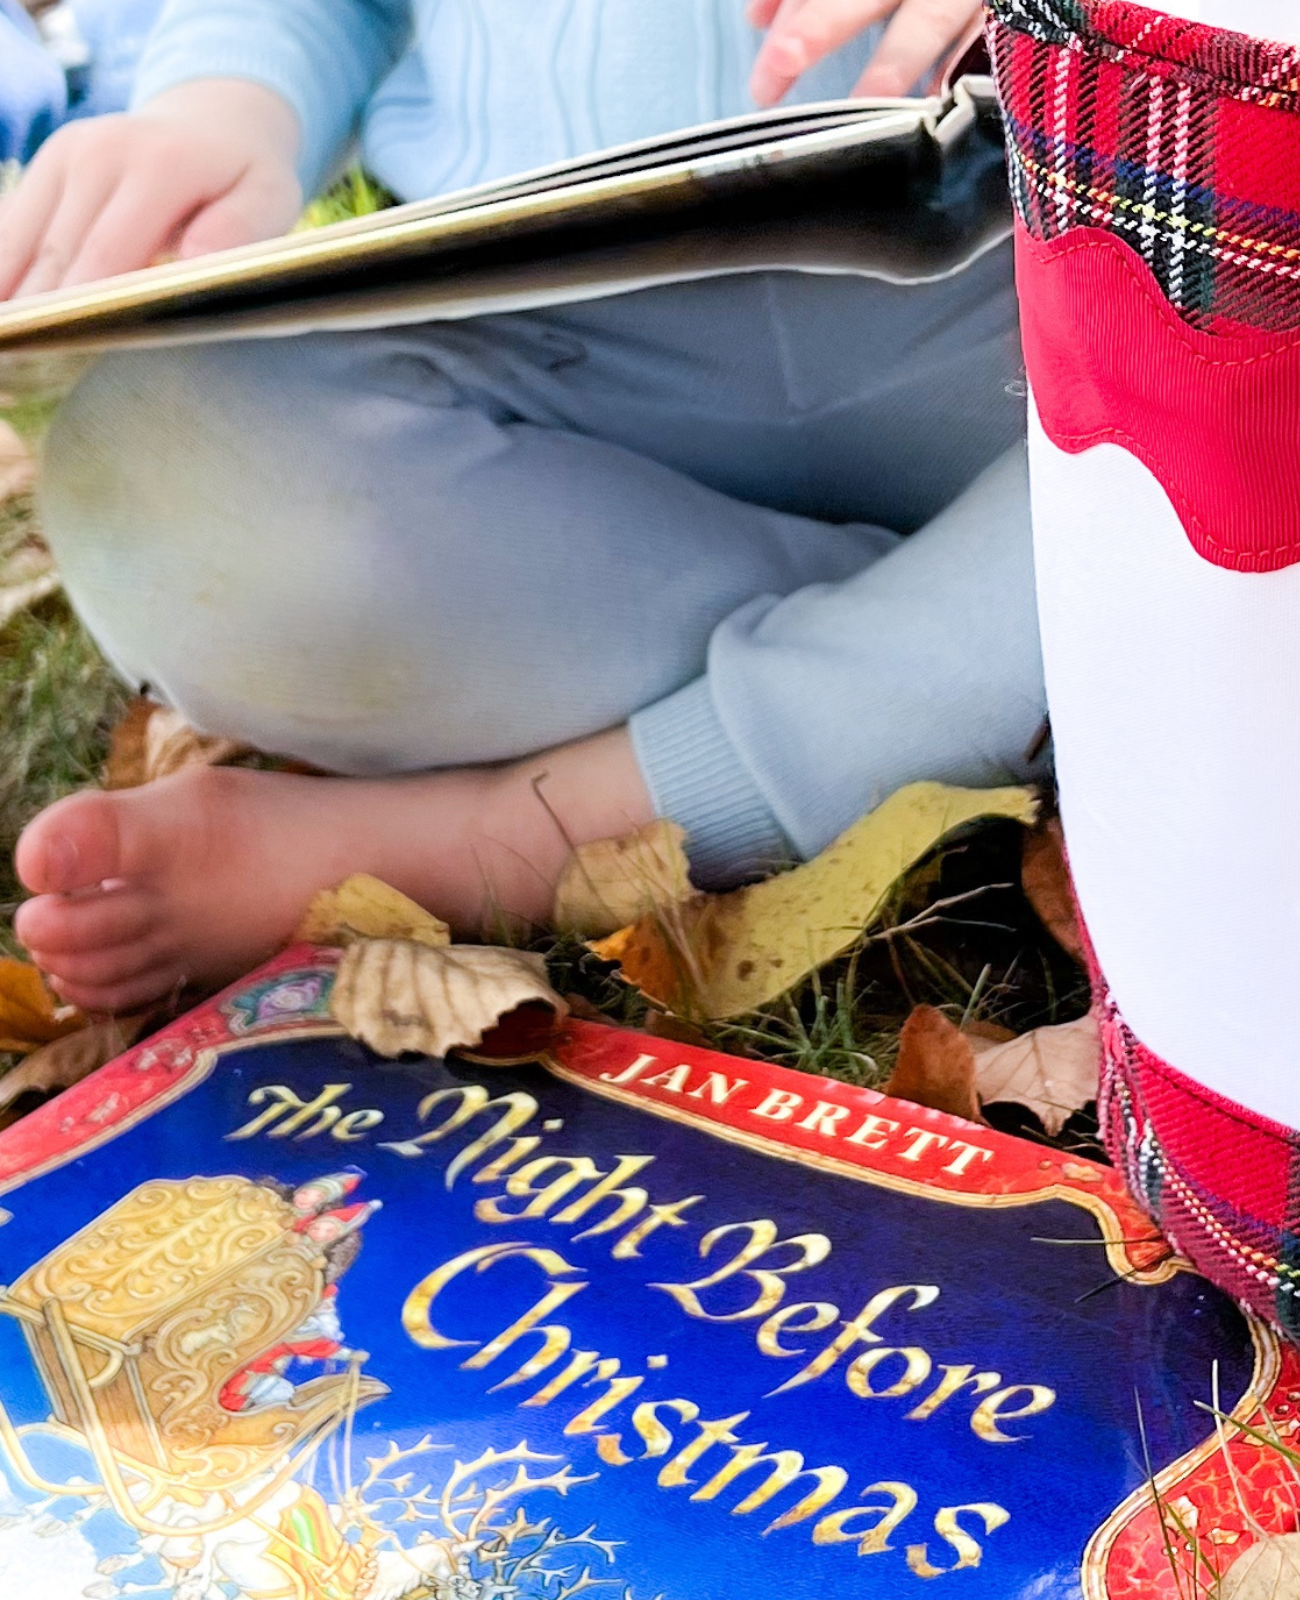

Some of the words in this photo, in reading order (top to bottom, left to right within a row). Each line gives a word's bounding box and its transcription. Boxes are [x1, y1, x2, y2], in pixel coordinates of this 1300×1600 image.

[224, 1082, 385, 1142] The
[376, 1084, 706, 1260] Night
[646, 1218, 1056, 1444] Before
[602, 1052, 748, 1106] JAN
[749, 1086, 994, 1178] BRETT
[402, 1241, 1011, 1579] Christmas
